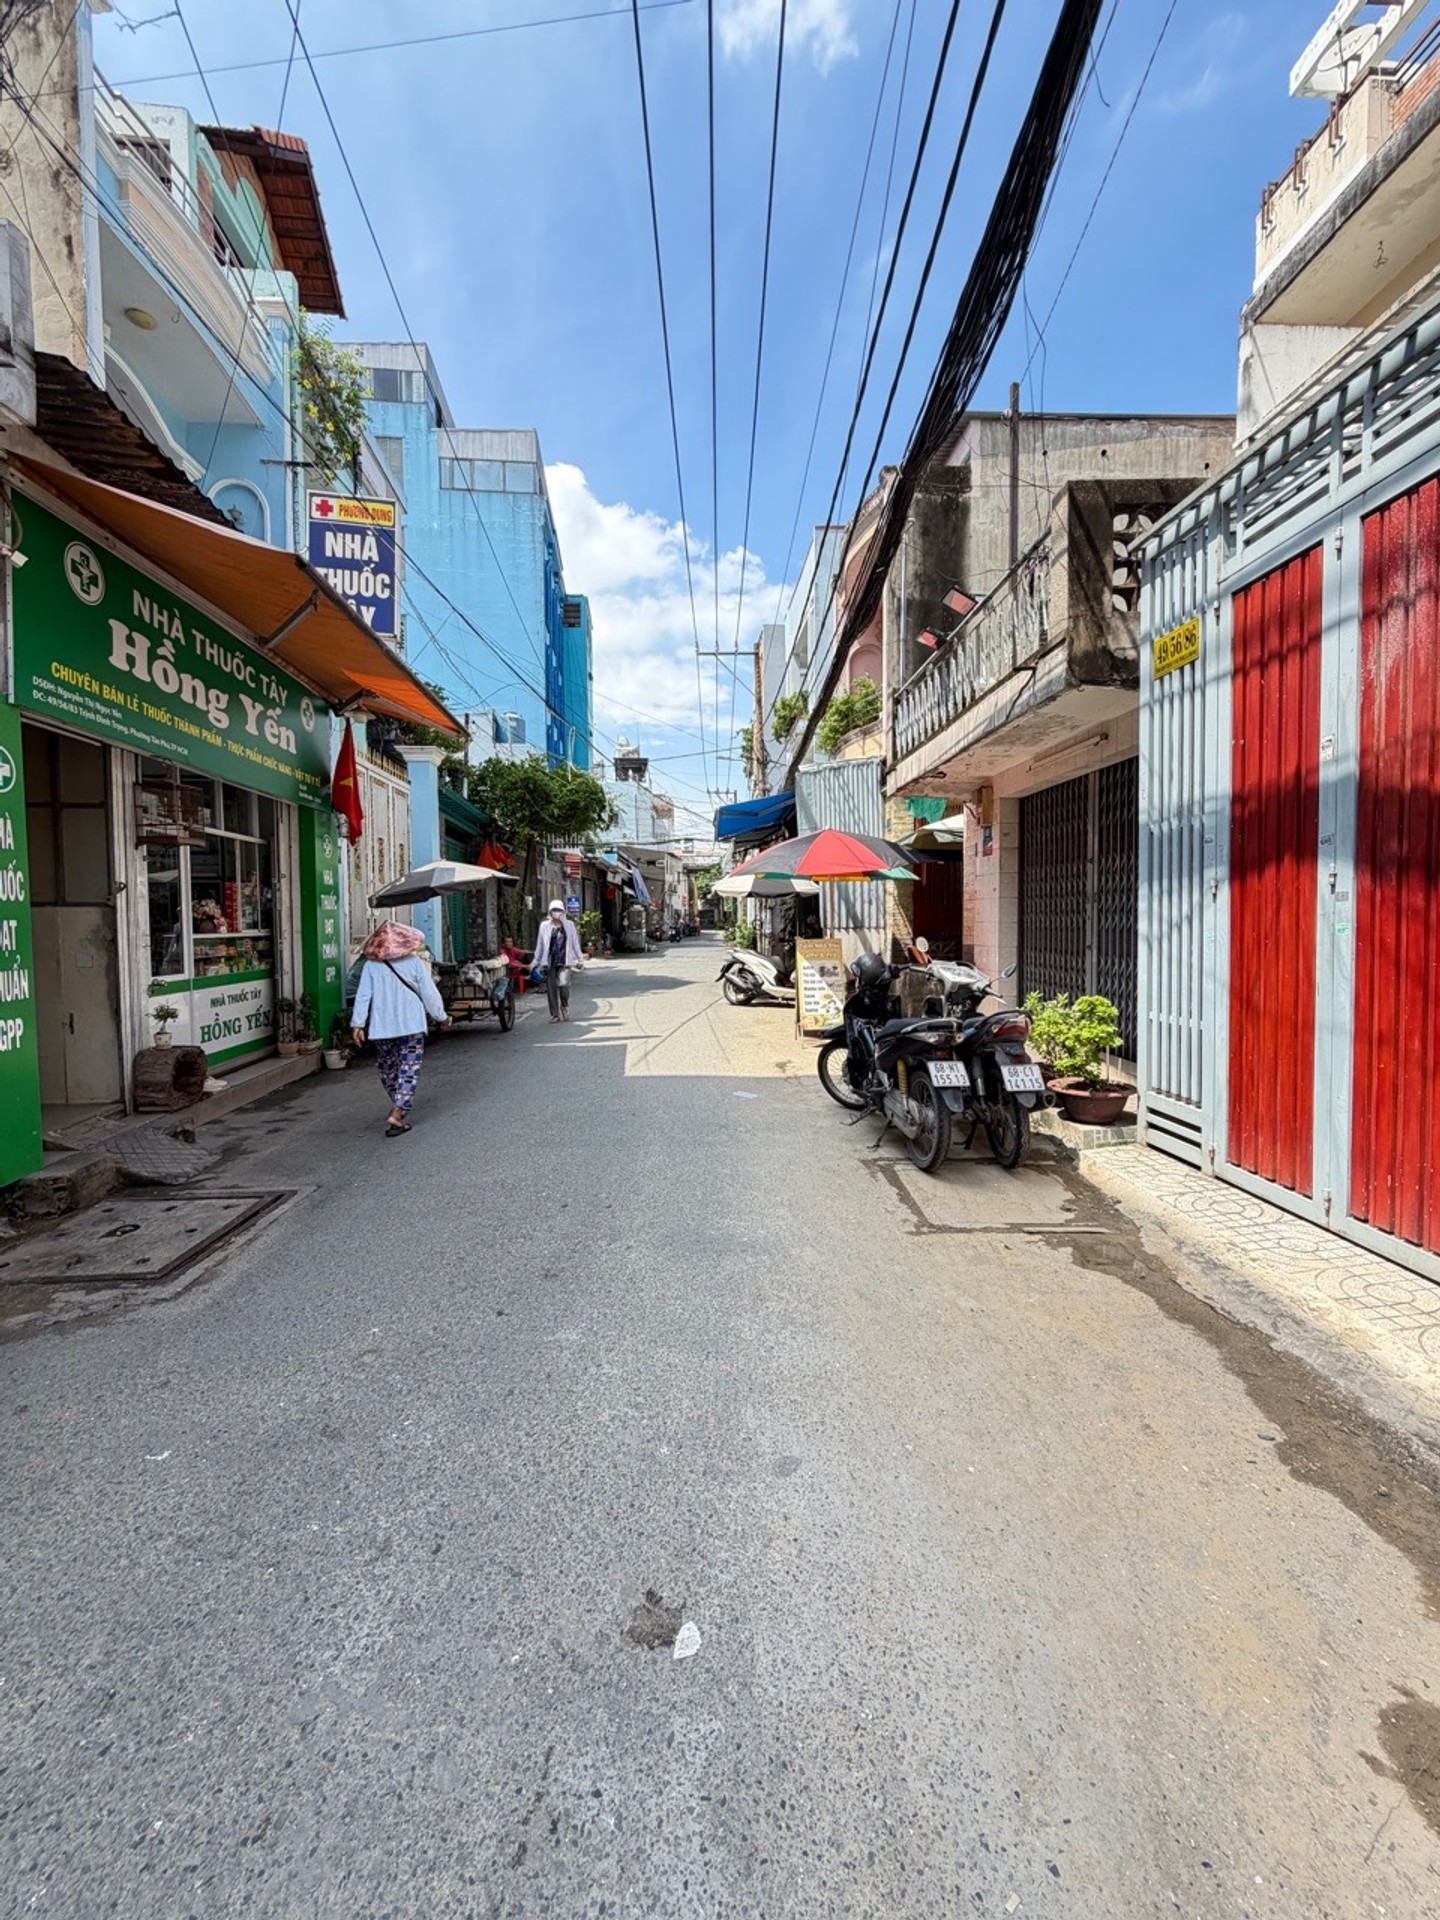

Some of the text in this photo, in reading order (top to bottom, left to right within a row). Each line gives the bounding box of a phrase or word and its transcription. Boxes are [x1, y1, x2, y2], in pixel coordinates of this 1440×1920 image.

[325, 529, 380, 562] NHÀ
[133, 588, 288, 707] NHÀ THUỐC TÂY
[51, 661, 100, 695] CHUYÊN
[102, 683, 125, 706] BÁN
[127, 693, 140, 713] LẺ
[141, 701, 172, 726] THUỐC
[108, 618, 297, 755] Hồng Yến
[0, 811, 15, 850] HÀ
[0, 859, 25, 902] UỐC
[0, 919, 18, 957] ẠT
[0, 954, 30, 1002] HUẨN
[210, 986, 263, 1009] NHÀ THUỐC TÂY
[199, 1003, 272, 1044] HỒNG YẾN
